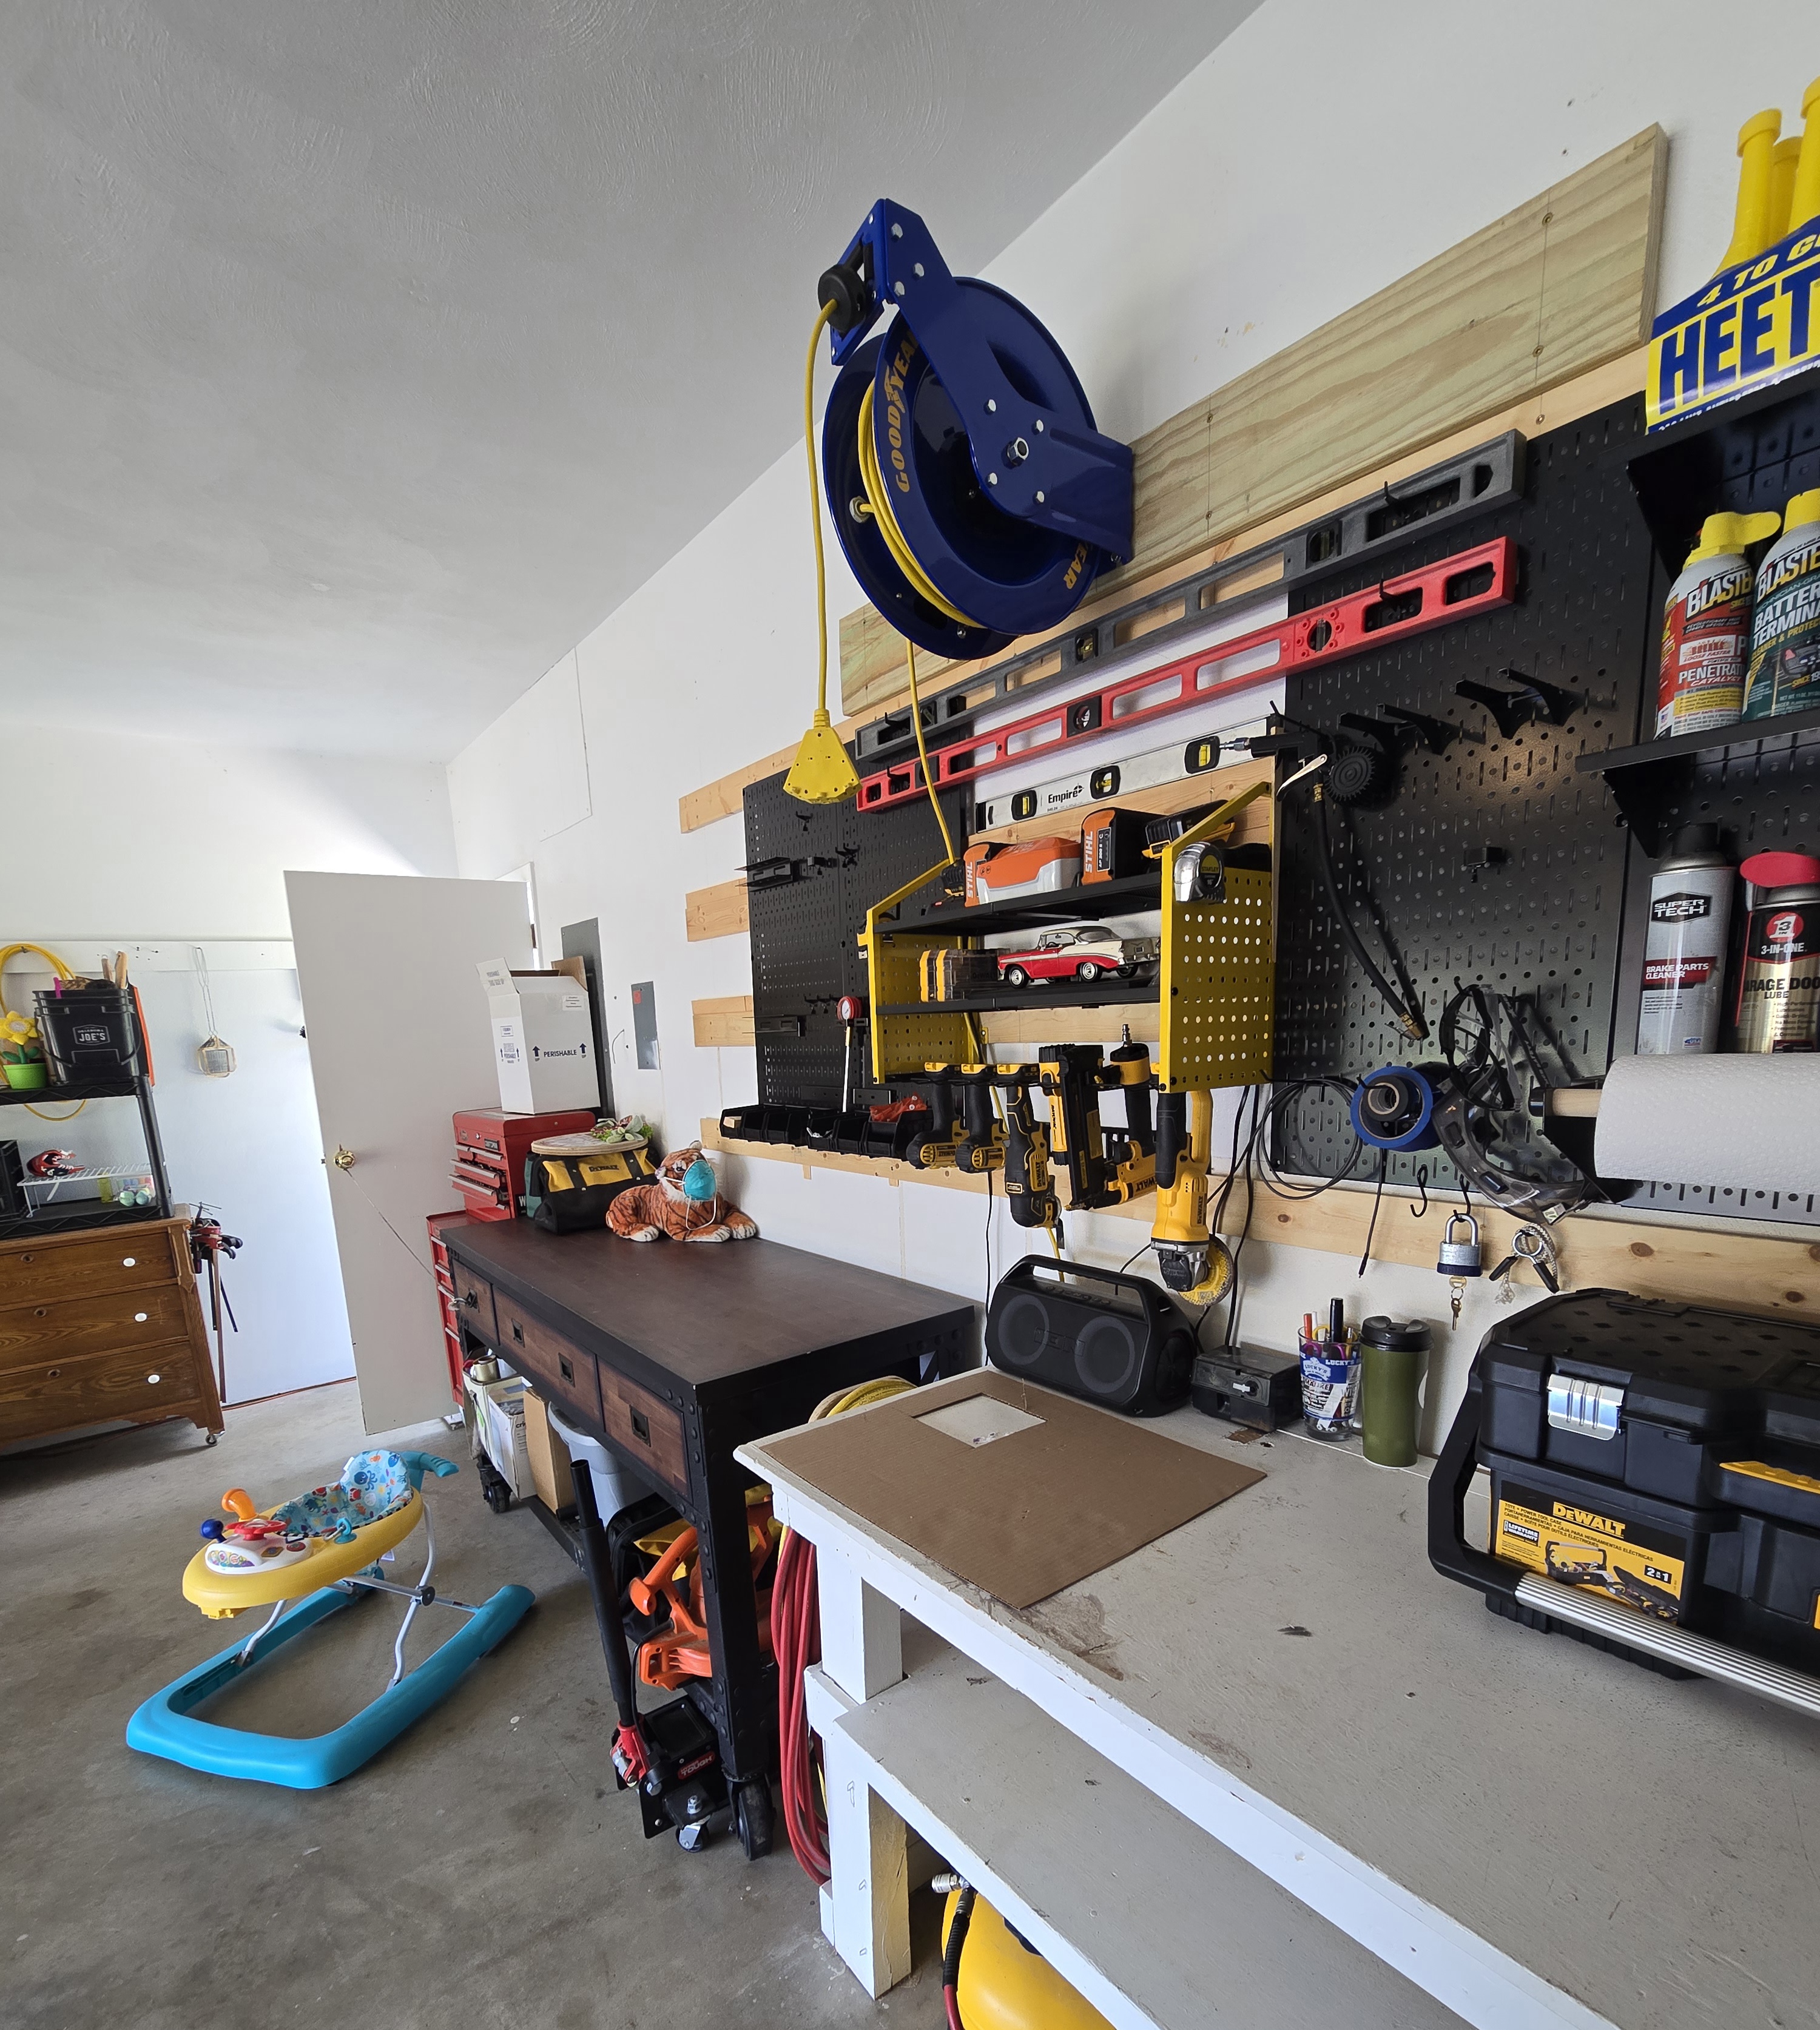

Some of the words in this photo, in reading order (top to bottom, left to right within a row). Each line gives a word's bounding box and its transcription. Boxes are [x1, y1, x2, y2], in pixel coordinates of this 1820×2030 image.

[1697, 283, 1723, 307] 4
[1733, 254, 1779, 291] TO
[1787, 234, 1820, 261] G
[1659, 262, 1820, 415] HEET
[884, 331, 920, 493] GOODYEA
[1757, 545, 1820, 604] BLASTE
[1687, 569, 1753, 618] BLASTE
[1753, 581, 1820, 633] BATTER
[1753, 600, 1820, 650] TERMINA
[1778, 633, 1785, 643] &
[1787, 617, 1820, 638] PROTEC
[1691, 676, 1742, 687] CATALYST
[1048, 789, 1079, 804] Empire
[1085, 831, 1093, 874] STIHL
[1654, 899, 1705, 910] SUPER
[1654, 906, 1704, 918] TECH
[1778, 921, 1791, 931] 3
[1761, 942, 1805, 955] 3-IN-ONE
[1645, 971, 1686, 980] CLEANER
[1646, 964, 1675, 973] BRAKE
[1676, 963, 1709, 971] PARTS
[1744, 978, 1786, 992] ARAGE
[1788, 976, 1820, 990] DOO
[1764, 990, 1789, 1000] LUBE
[79, 1033, 106, 1042] JOE'S
[544, 1049, 577, 1057] PERISHABLE
[1136, 1176, 1156, 1192] WALT
[1304, 1364, 1327, 1374] LUCKY'S
[1520, 1507, 1537, 1516] POWER
[1504, 1512, 1519, 1520] CAISSE
[1551, 1528, 1567, 1537] OUTILS
[1554, 1503, 1626, 1537] DeWALT
[1508, 1522, 1539, 1537] LIFETIME
[1508, 1528, 1538, 1541] WARRANTY
[1584, 1534, 1622, 1551] HERRAMIENTAS
[1623, 1547, 1654, 1562] ELÉCTRICAS
[1646, 1567, 1655, 1577] 2
[1662, 1573, 1669, 1582] 1
[681, 1755, 713, 1776] TOUGH
